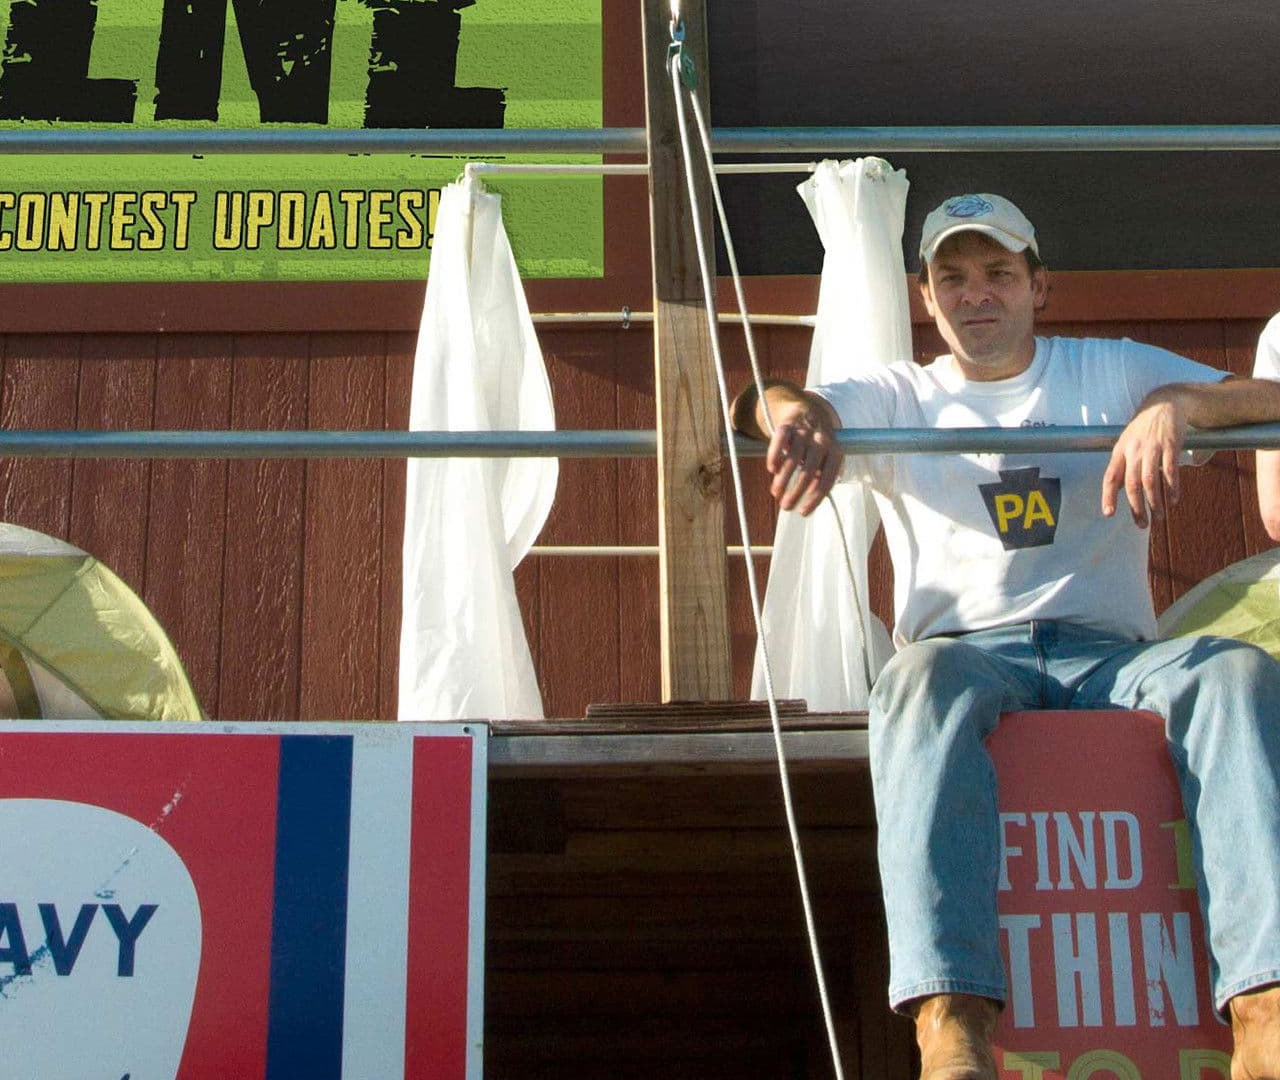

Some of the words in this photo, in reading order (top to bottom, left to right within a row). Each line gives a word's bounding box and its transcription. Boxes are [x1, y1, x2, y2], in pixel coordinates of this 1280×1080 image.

[212, 189, 441, 251] UPDATES!
[993, 489, 1055, 533] PA
[999, 810, 1144, 891] FIND
[999, 912, 1228, 1028] THIN
